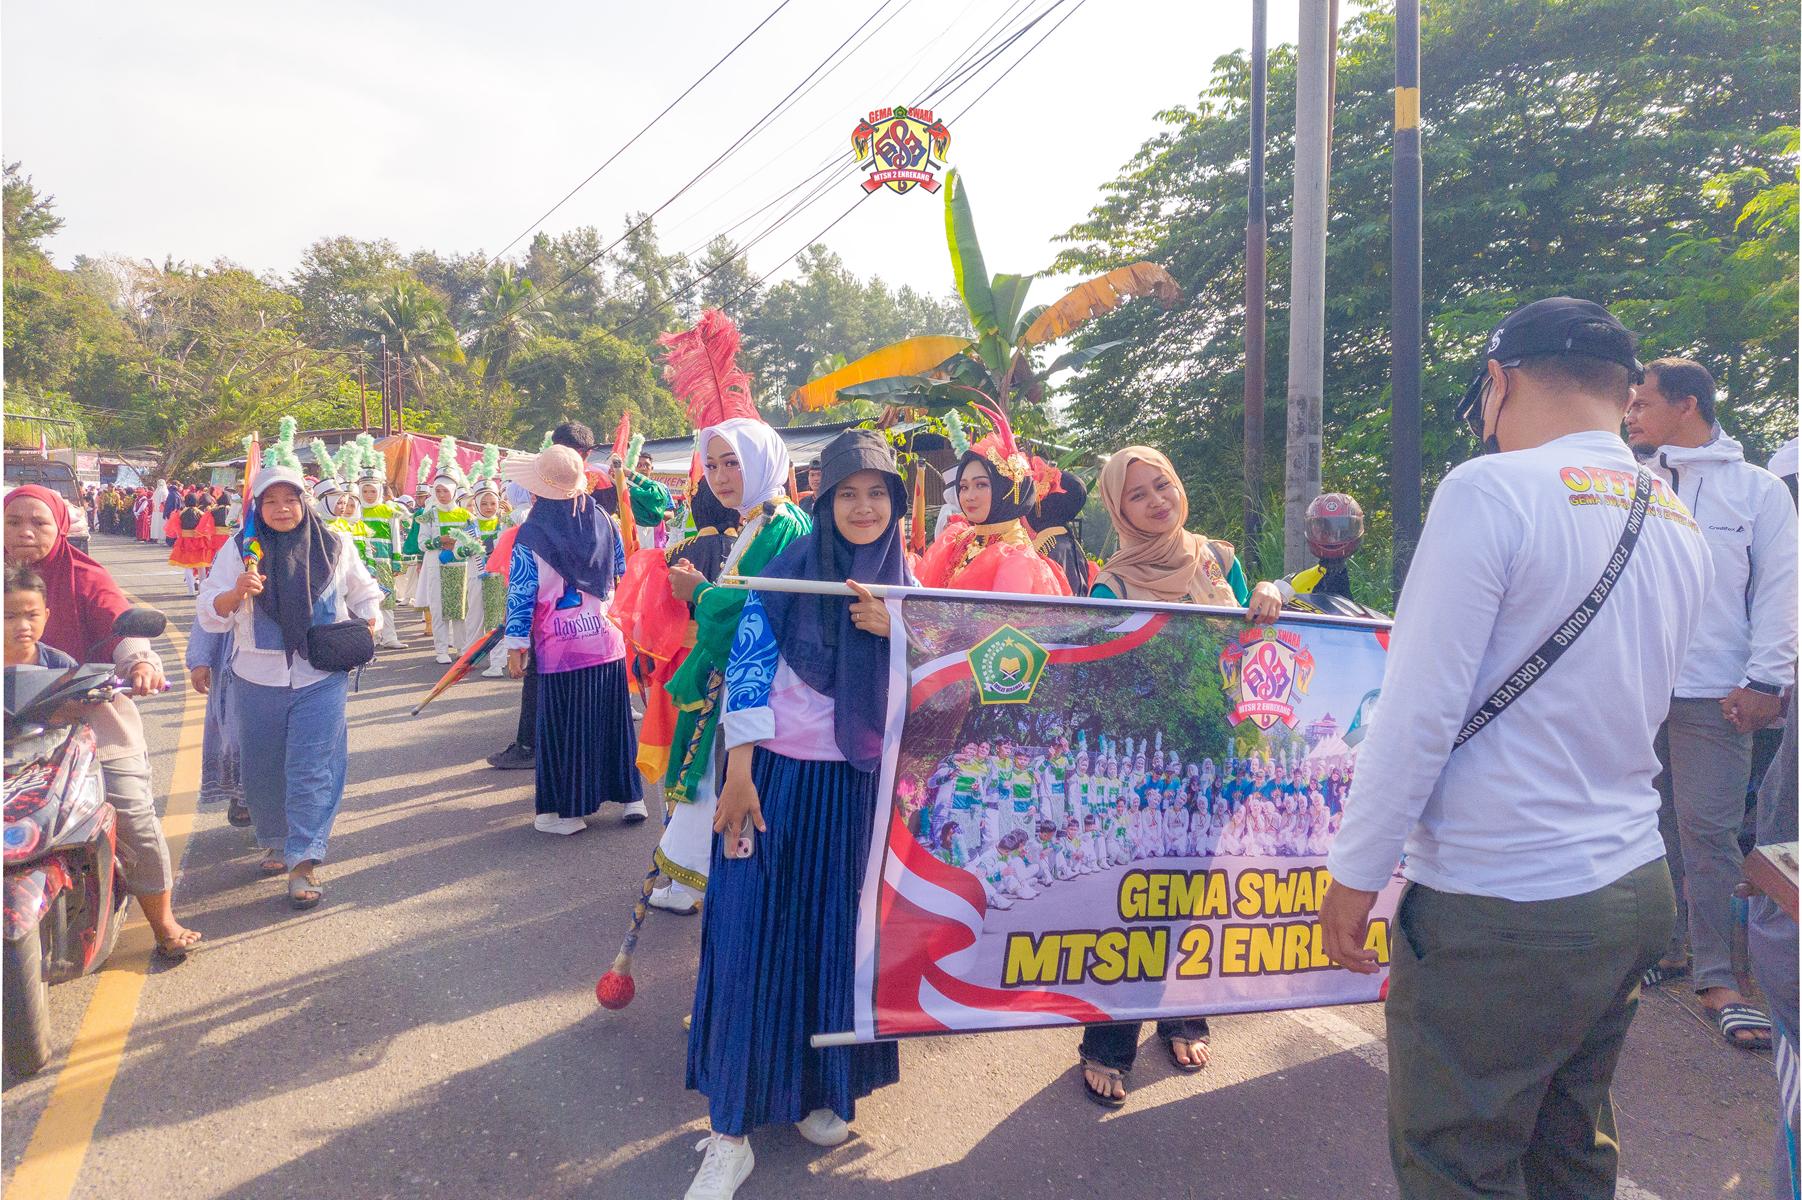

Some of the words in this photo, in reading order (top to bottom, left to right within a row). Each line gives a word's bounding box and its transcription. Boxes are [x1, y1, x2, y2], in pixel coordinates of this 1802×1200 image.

[1628, 496, 1648, 534] YOUNG
[1591, 545, 1628, 604] FOREVER
[554, 612, 601, 637] flagship
[1553, 605, 1594, 646] YOUNG
[1489, 655, 1548, 708] FOREVER
[1257, 703, 1261, 711] 2
[1119, 869, 1231, 921] GEMA
[1235, 866, 1333, 918] SWAR
[1001, 927, 1169, 987] MTSN
[1176, 923, 1214, 980] 2
